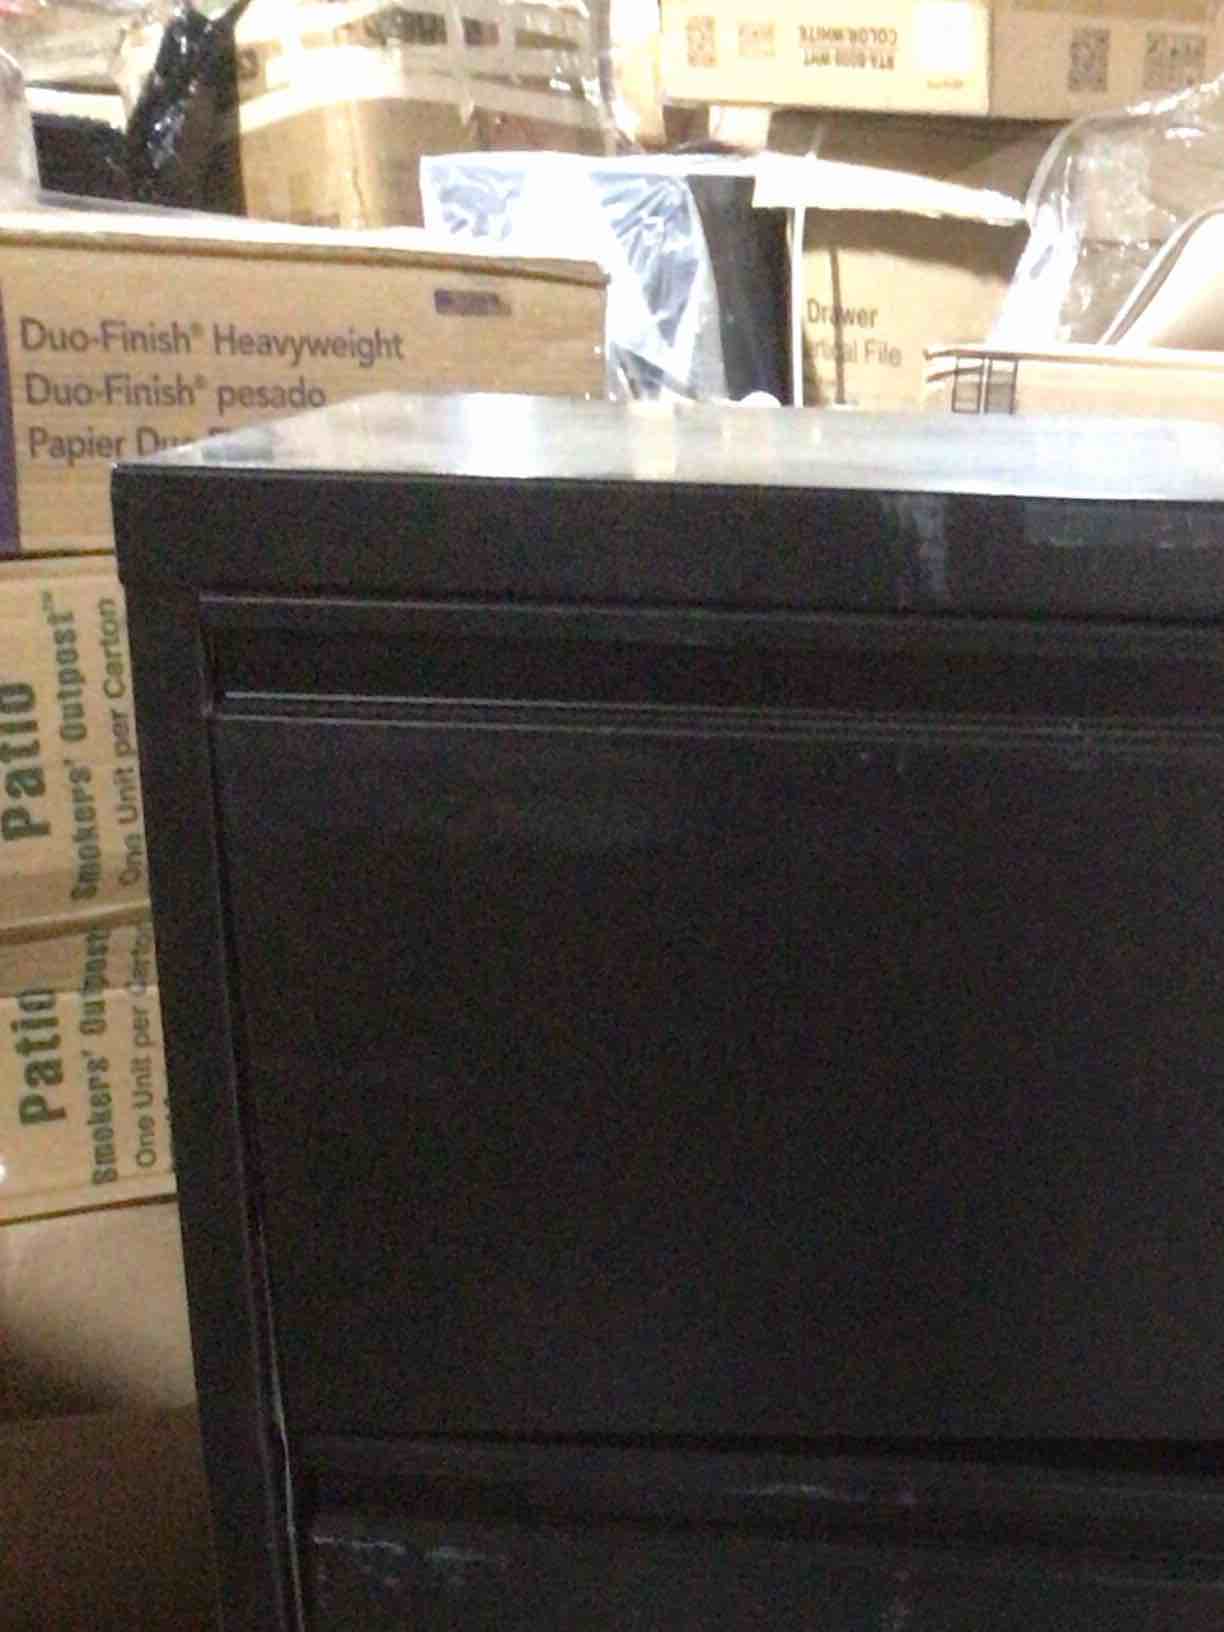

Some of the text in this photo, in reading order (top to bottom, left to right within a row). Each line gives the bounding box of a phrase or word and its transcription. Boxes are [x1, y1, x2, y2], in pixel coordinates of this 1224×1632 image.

[213, 324, 403, 367] Heavyweight
[217, 376, 326, 413] pesado
[29, 427, 126, 467] Papier
[0, 682, 50, 841] Patio
[97, 597, 143, 887] One Unit per Carton
[131, 1006, 156, 1048] per
[10, 989, 67, 1125] Patio
[131, 1056, 153, 1109] Unit
[135, 1116, 157, 1168] One
